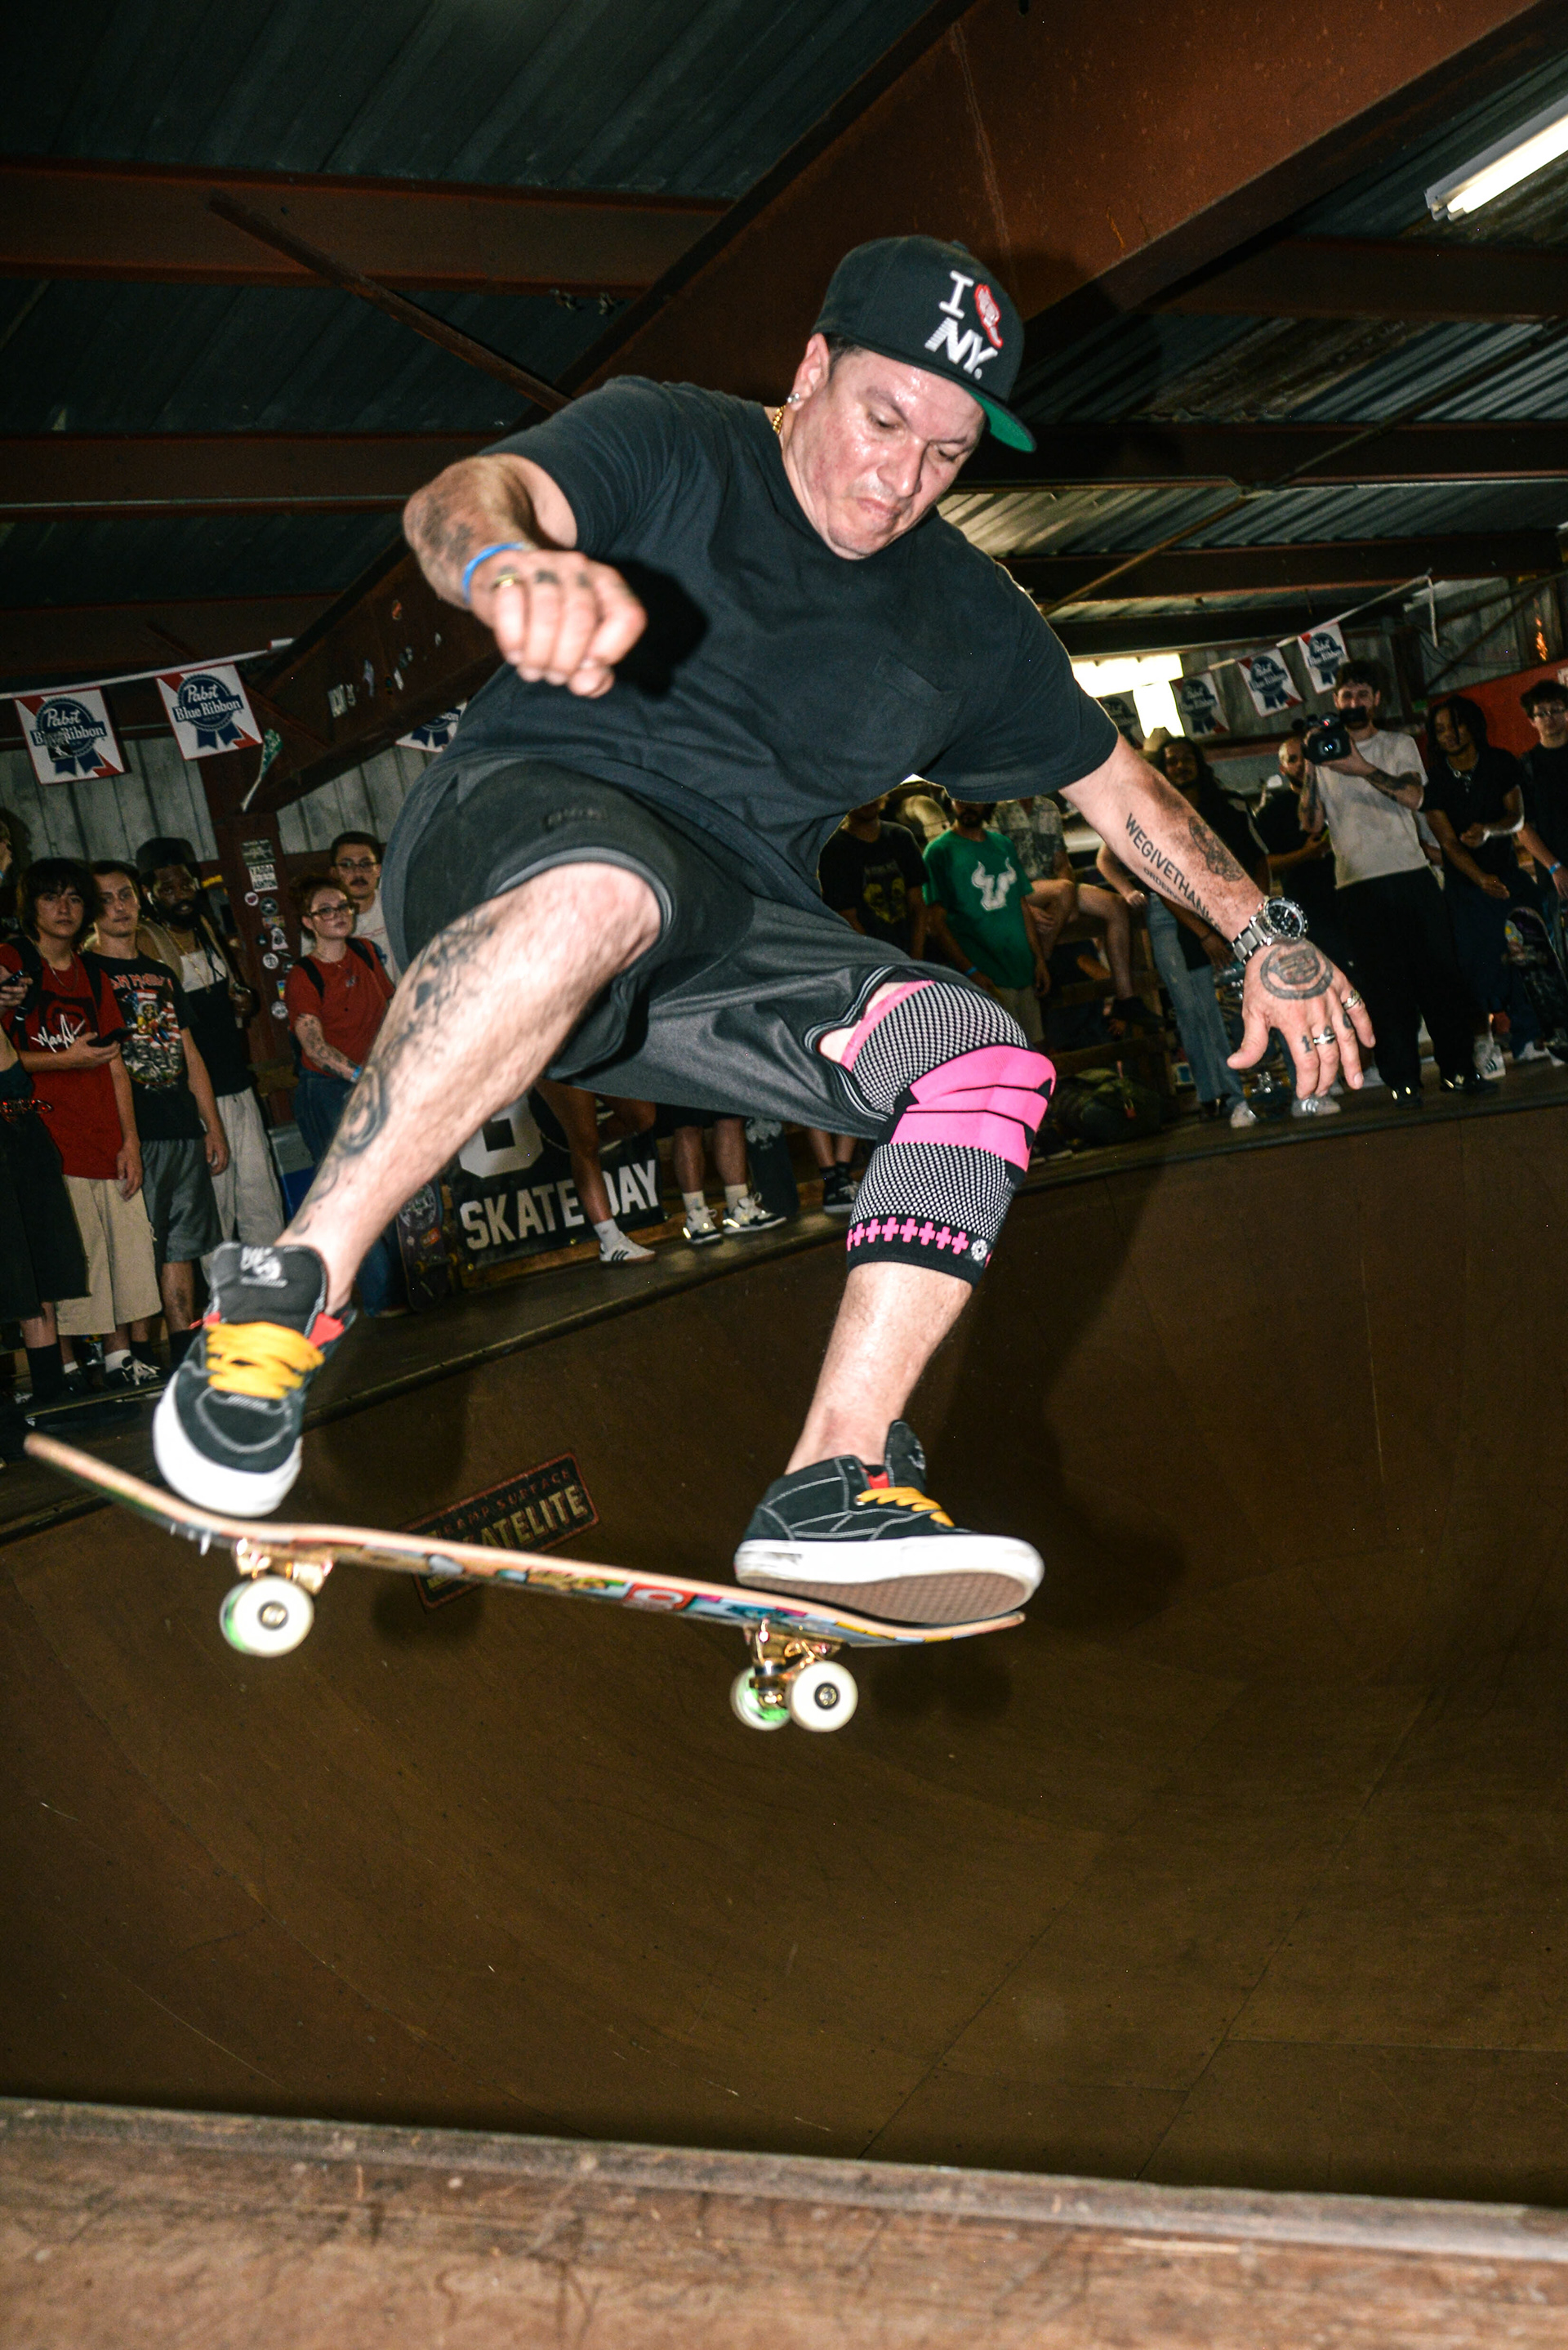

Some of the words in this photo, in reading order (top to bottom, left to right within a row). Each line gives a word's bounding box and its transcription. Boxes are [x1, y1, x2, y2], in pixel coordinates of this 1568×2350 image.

[938, 270, 975, 319] I
[183, 684, 219, 703] Pabst
[42, 707, 82, 728] Pabst
[175, 706, 202, 720] Blue
[200, 699, 242, 716] Ribbon
[459, 1179, 585, 1251] SKATE
[497, 1469, 571, 1511] SURFACE
